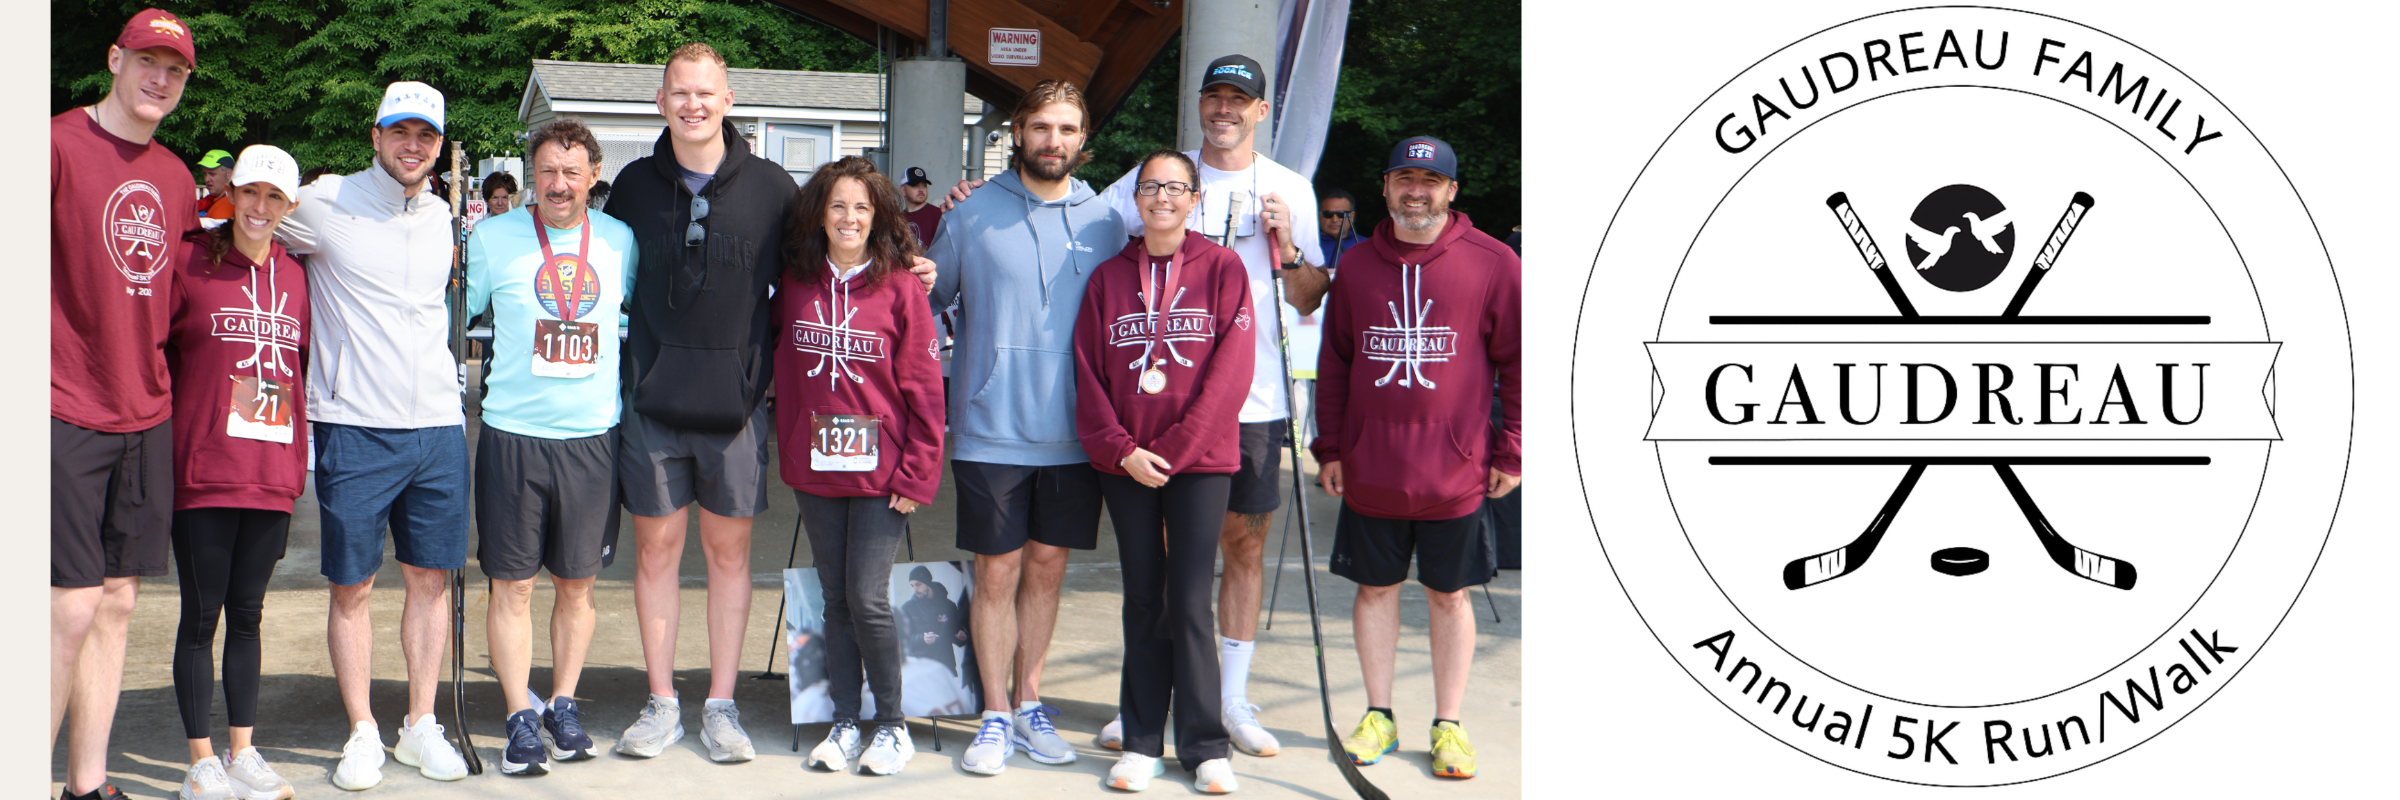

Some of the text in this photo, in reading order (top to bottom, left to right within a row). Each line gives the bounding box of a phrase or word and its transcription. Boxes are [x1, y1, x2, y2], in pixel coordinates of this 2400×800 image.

[993, 32, 1037, 45] WARNING
[122, 225, 160, 240] GAUDREAU
[543, 333, 592, 361] 1103
[796, 329, 874, 353] GAUDREAU
[1370, 336, 1447, 352] GAUDREAU
[819, 427, 868, 453] 1321
